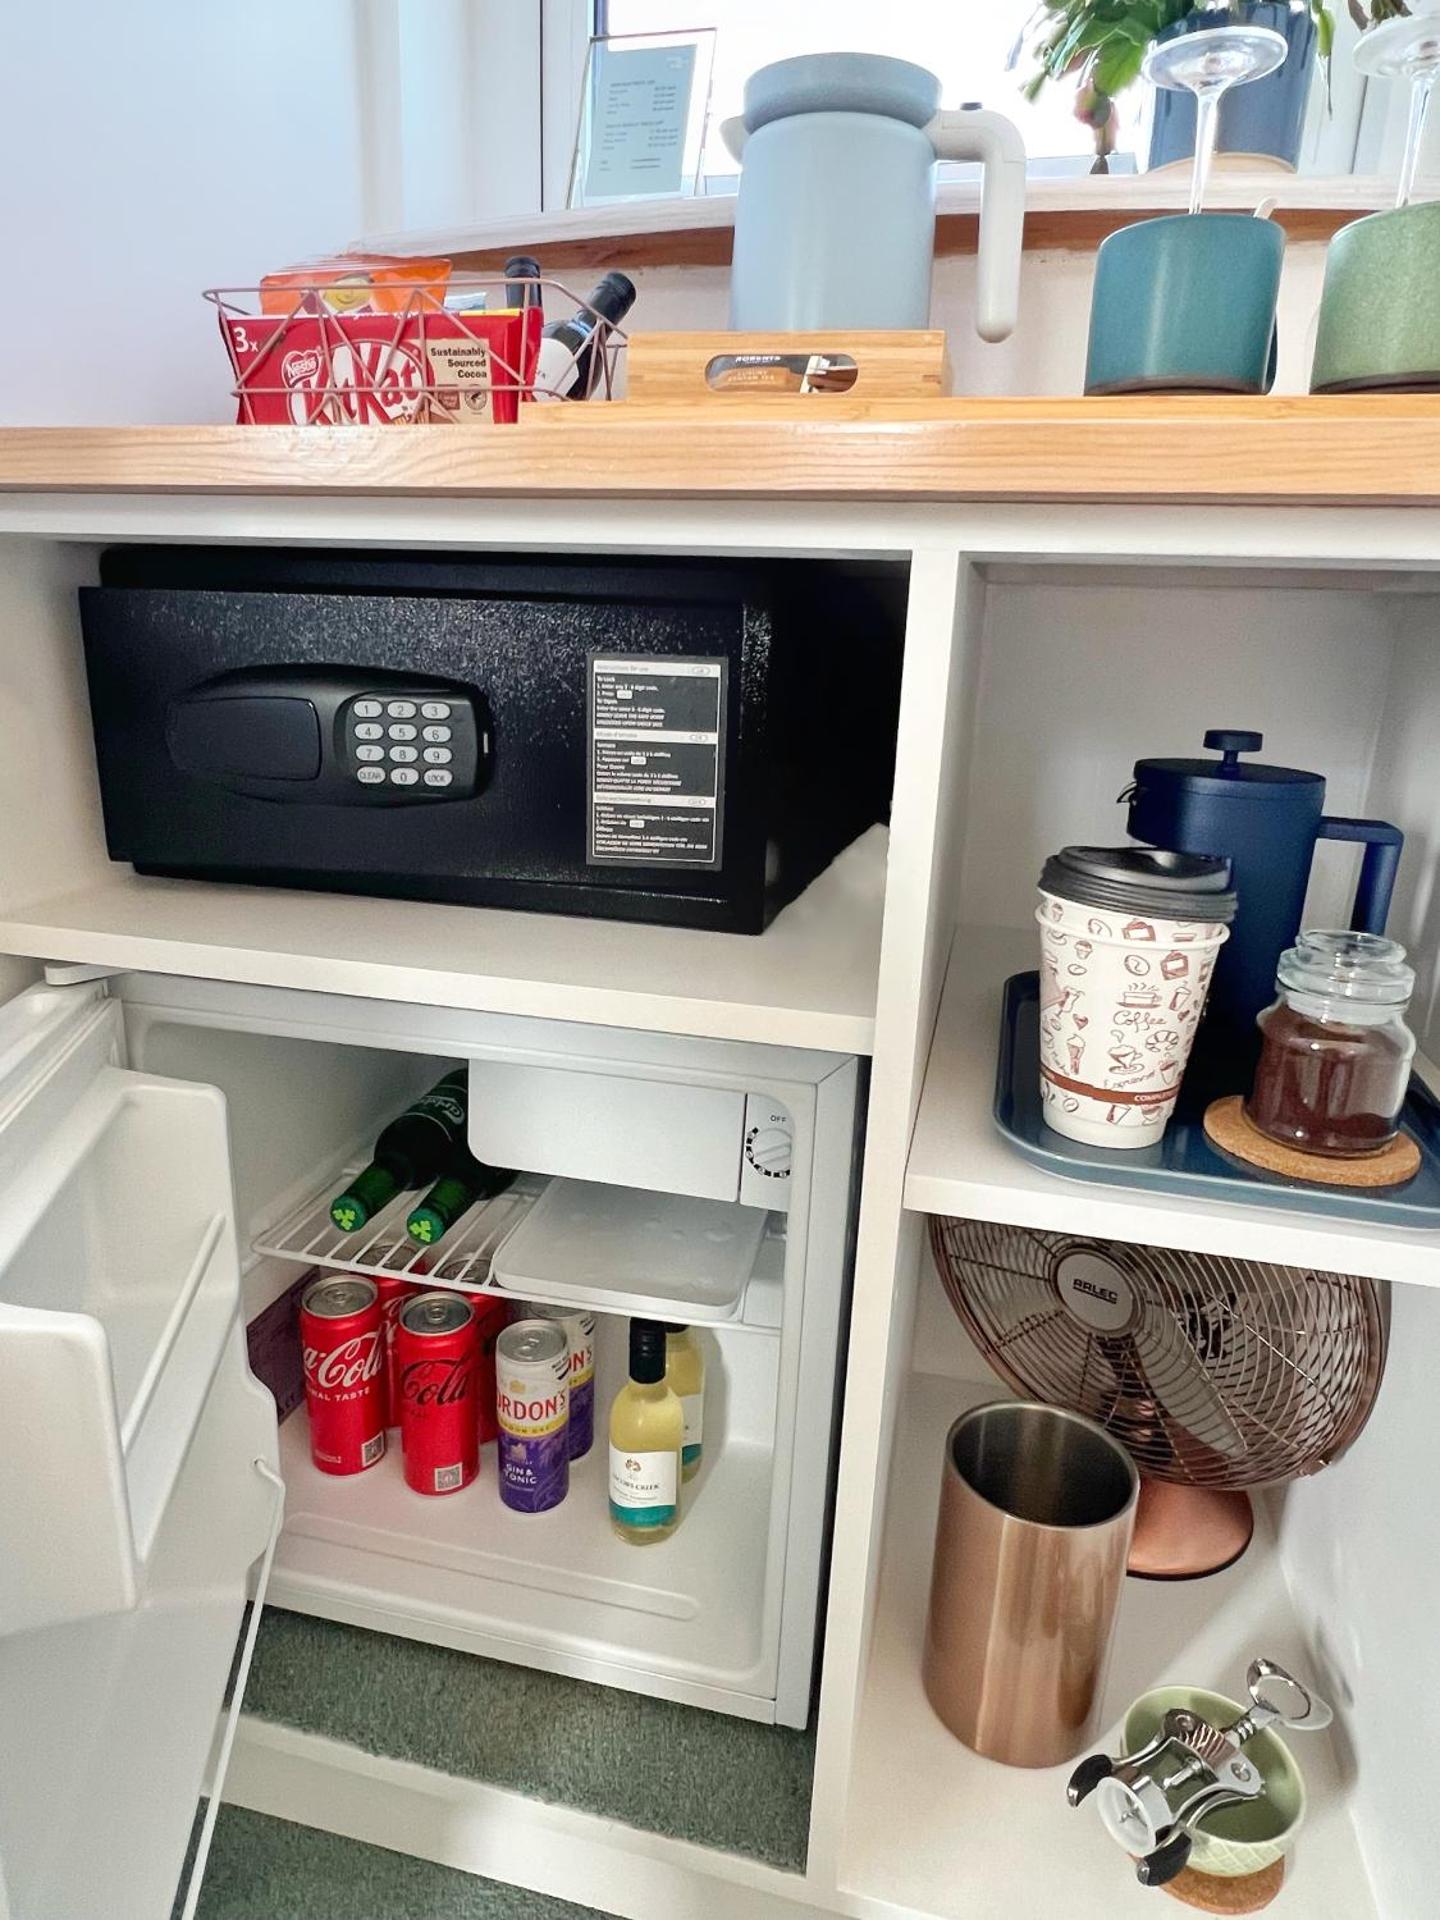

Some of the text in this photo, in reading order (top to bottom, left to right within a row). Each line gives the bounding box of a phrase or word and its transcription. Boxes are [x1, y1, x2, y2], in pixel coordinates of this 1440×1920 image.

[430, 347, 486, 358] Sustainably
[447, 358, 487, 368] Sourced
[457, 369, 488, 379] Cocoa
[364, 705, 438, 717] 1 2 3
[364, 726, 440, 740] 4 5 6
[366, 748, 440, 761] 7 8 9
[400, 772, 407, 782] 0
[1113, 1010, 1167, 1033] Coffee
[1072, 1278, 1118, 1301] ARLEC
